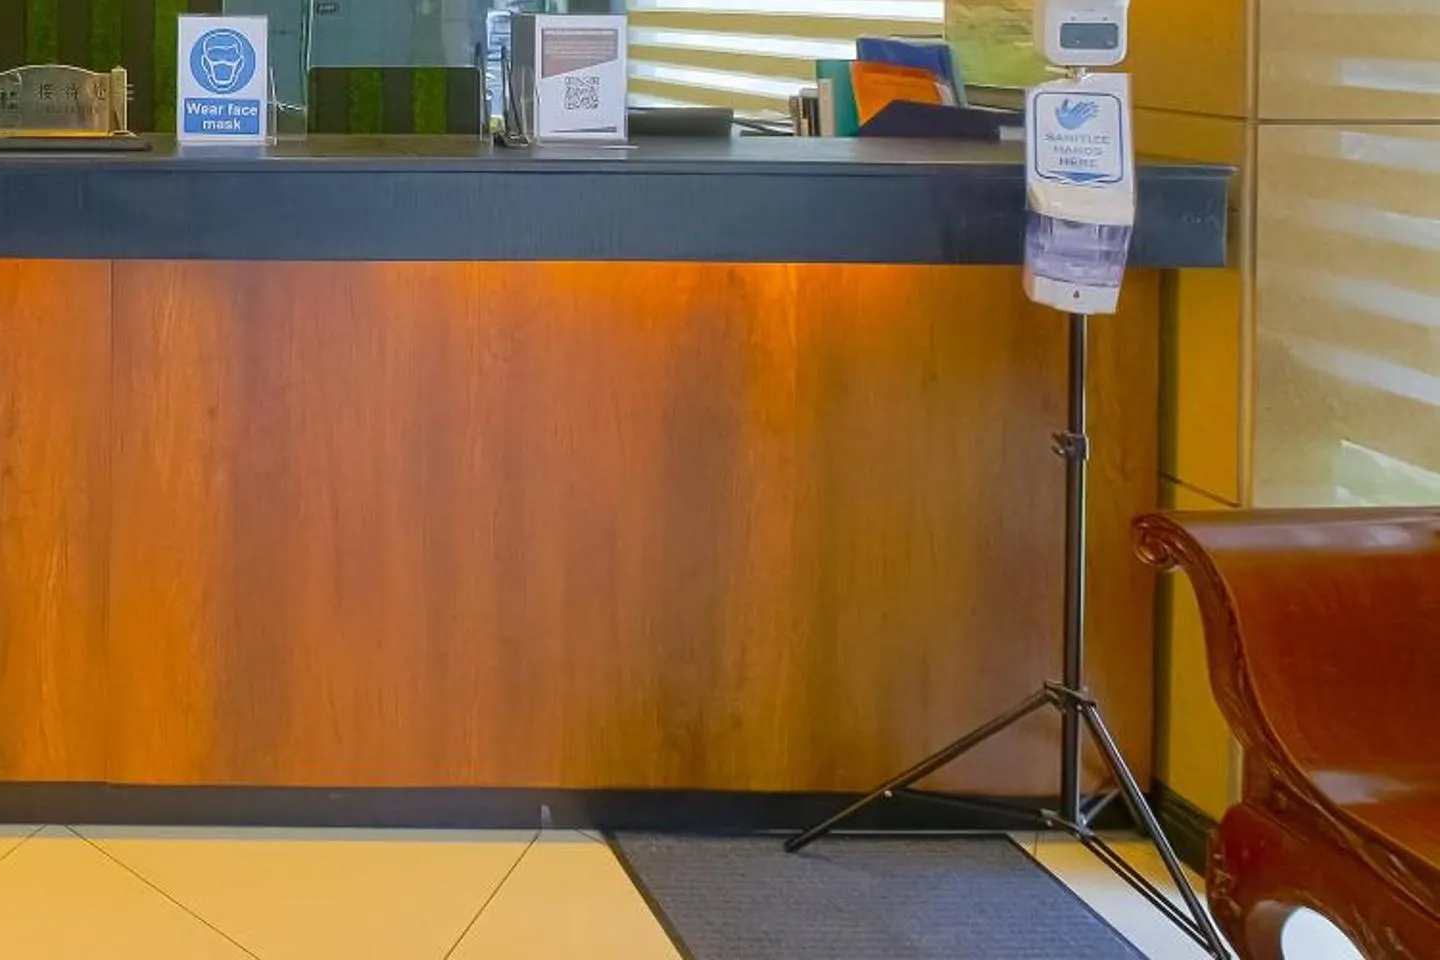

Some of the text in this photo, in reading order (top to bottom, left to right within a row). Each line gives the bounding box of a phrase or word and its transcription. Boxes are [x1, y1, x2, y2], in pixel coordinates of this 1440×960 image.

[186, 101, 258, 116] Wear face
[202, 119, 241, 131] mask
